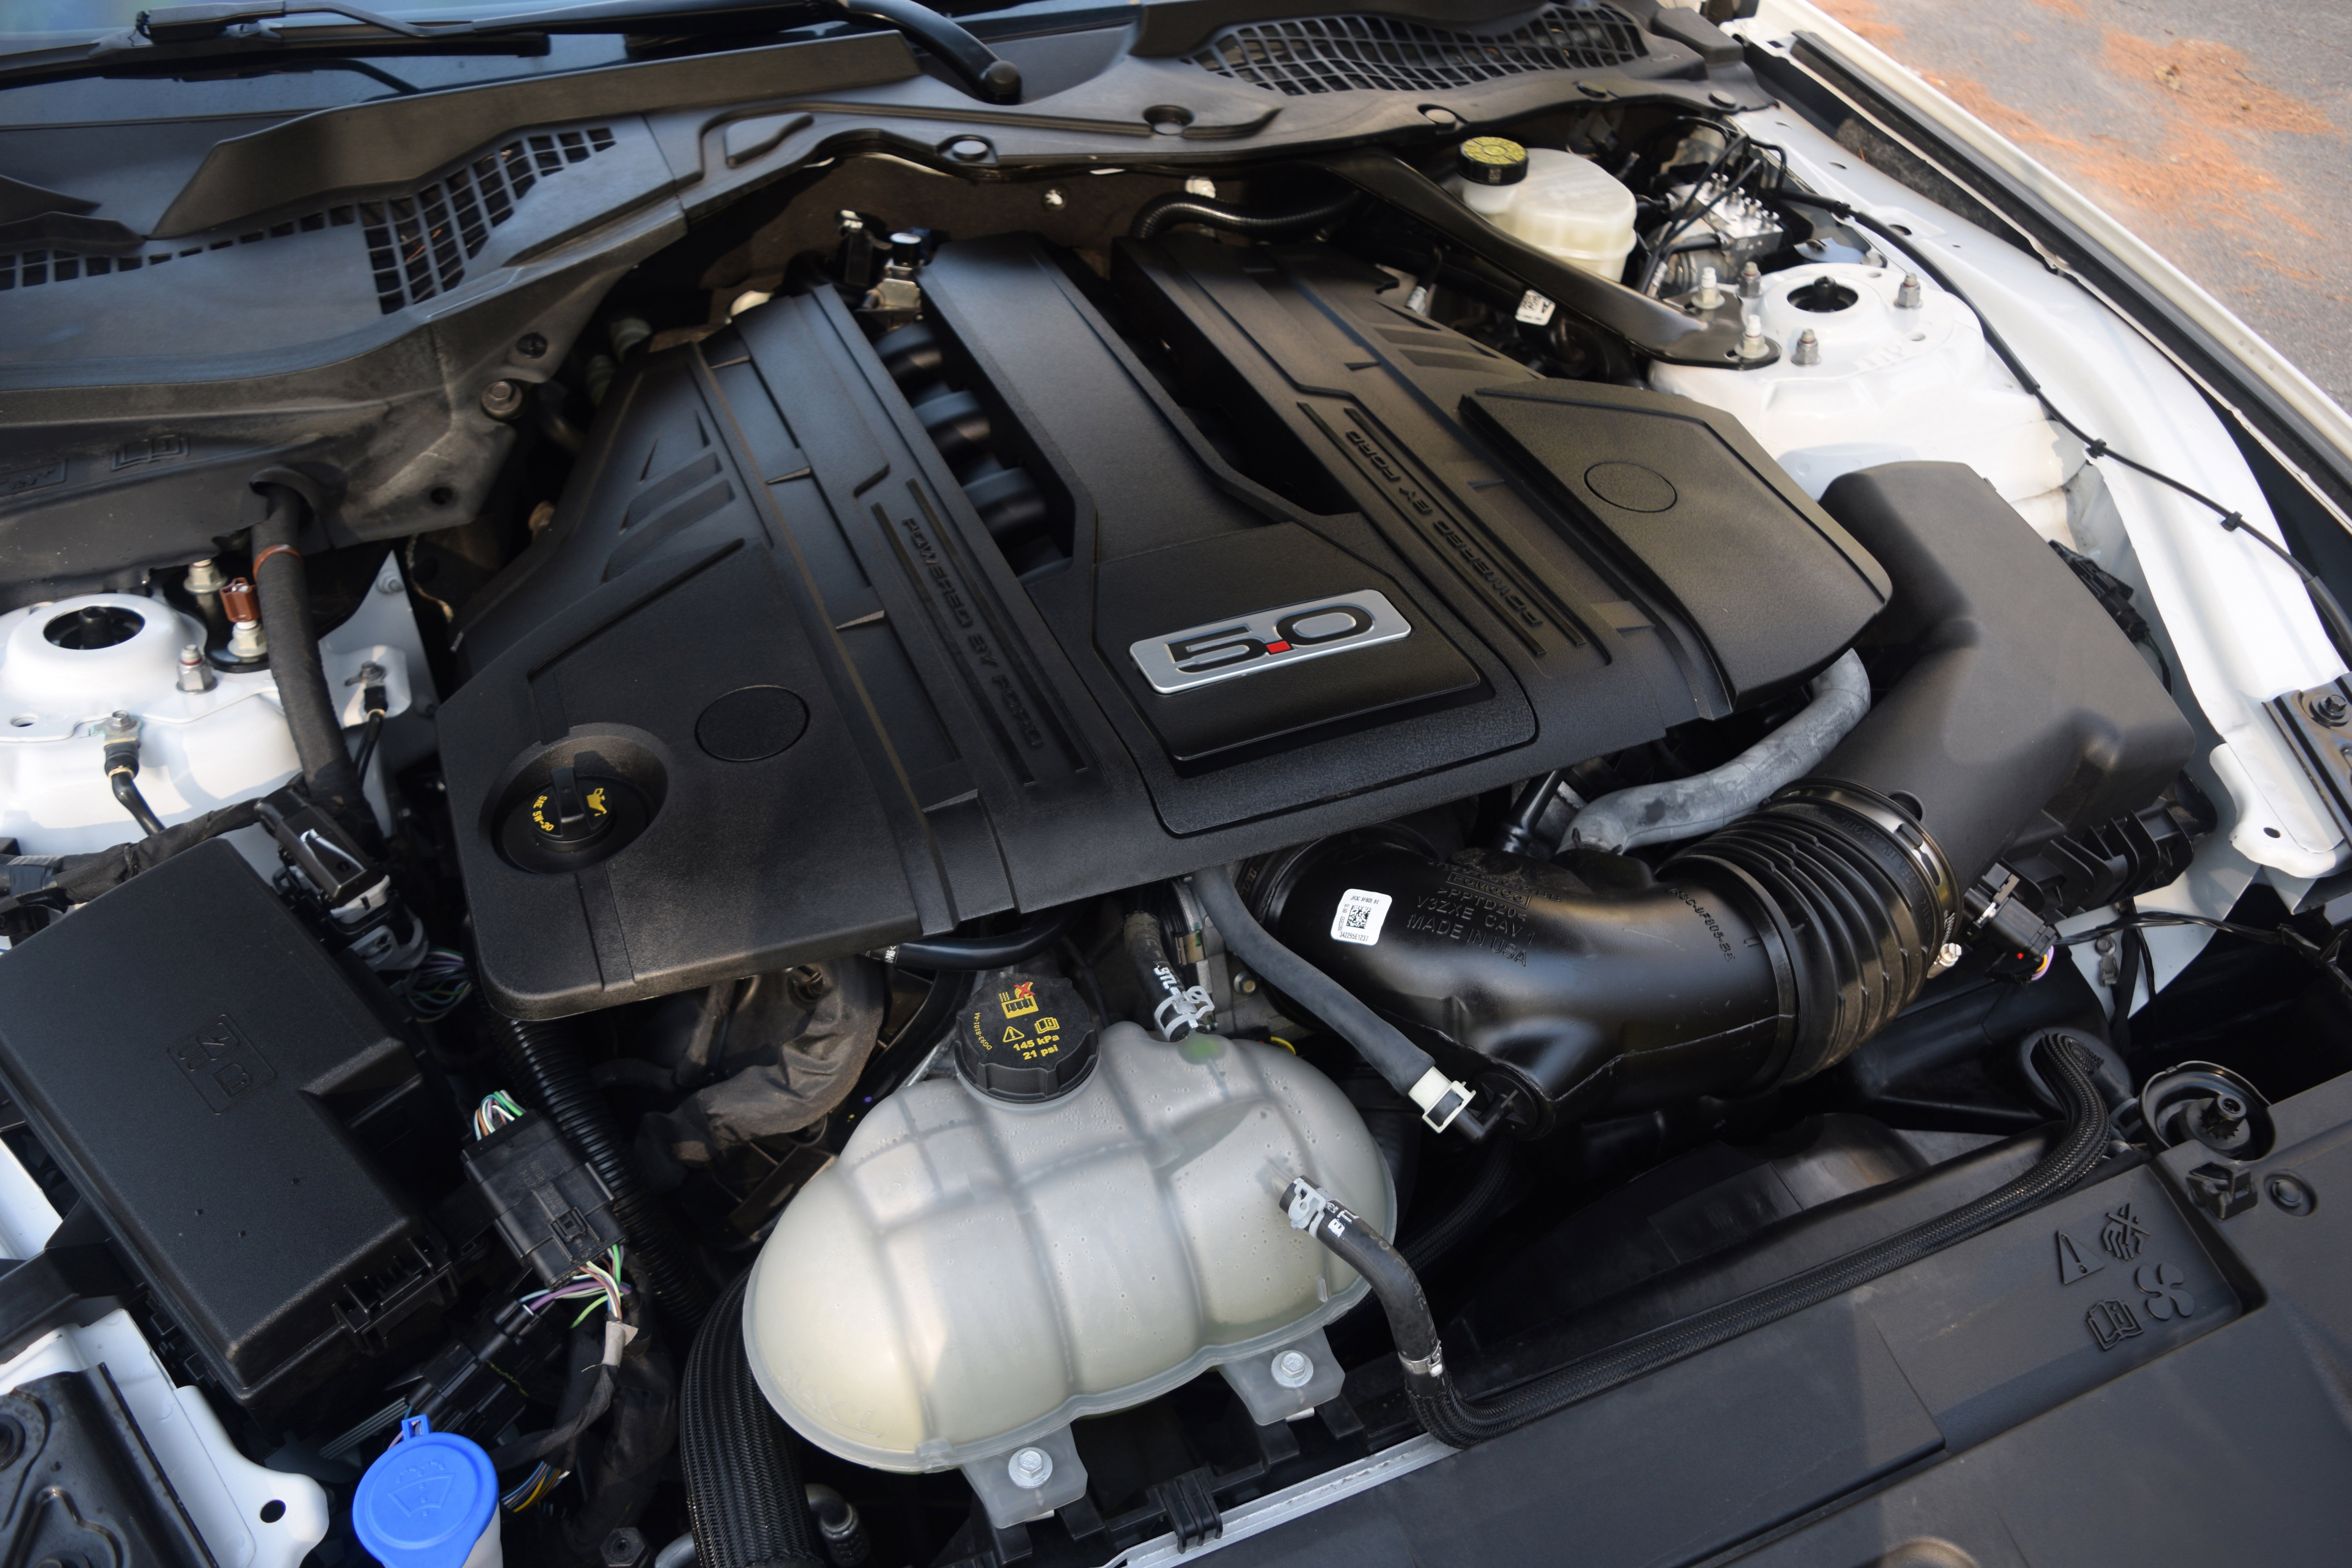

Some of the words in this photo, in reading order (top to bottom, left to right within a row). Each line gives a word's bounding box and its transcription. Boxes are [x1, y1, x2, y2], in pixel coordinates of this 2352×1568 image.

[1346, 430, 1401, 482] FORD
[1399, 488, 1433, 514] BY
[1433, 521, 1543, 626] POWERED
[902, 517, 973, 628] POWERED
[968, 633, 999, 667] BY
[991, 674, 1042, 747] FORD
[1164, 603, 1376, 674] 5.0
[533, 795, 548, 808] SAE
[532, 810, 554, 831] 5W-30
[1452, 874, 1524, 902] FoMoCo
[1339, 931, 1369, 942] 342295E1237
[1417, 895, 1474, 920] V3ZXE
[1484, 914, 1523, 938] CAV
[1528, 932, 1535, 945] 1
[1407, 914, 1464, 939] MADE
[1467, 928, 1487, 947] IN
[1490, 937, 1526, 967] USA
[974, 1012, 993, 1050] DG93-8101-AA
[1013, 1040, 1035, 1051] 145
[1036, 1034, 1060, 1046] kPa
[1022, 1050, 1037, 1060] 21
[1040, 1044, 1058, 1057] psi
